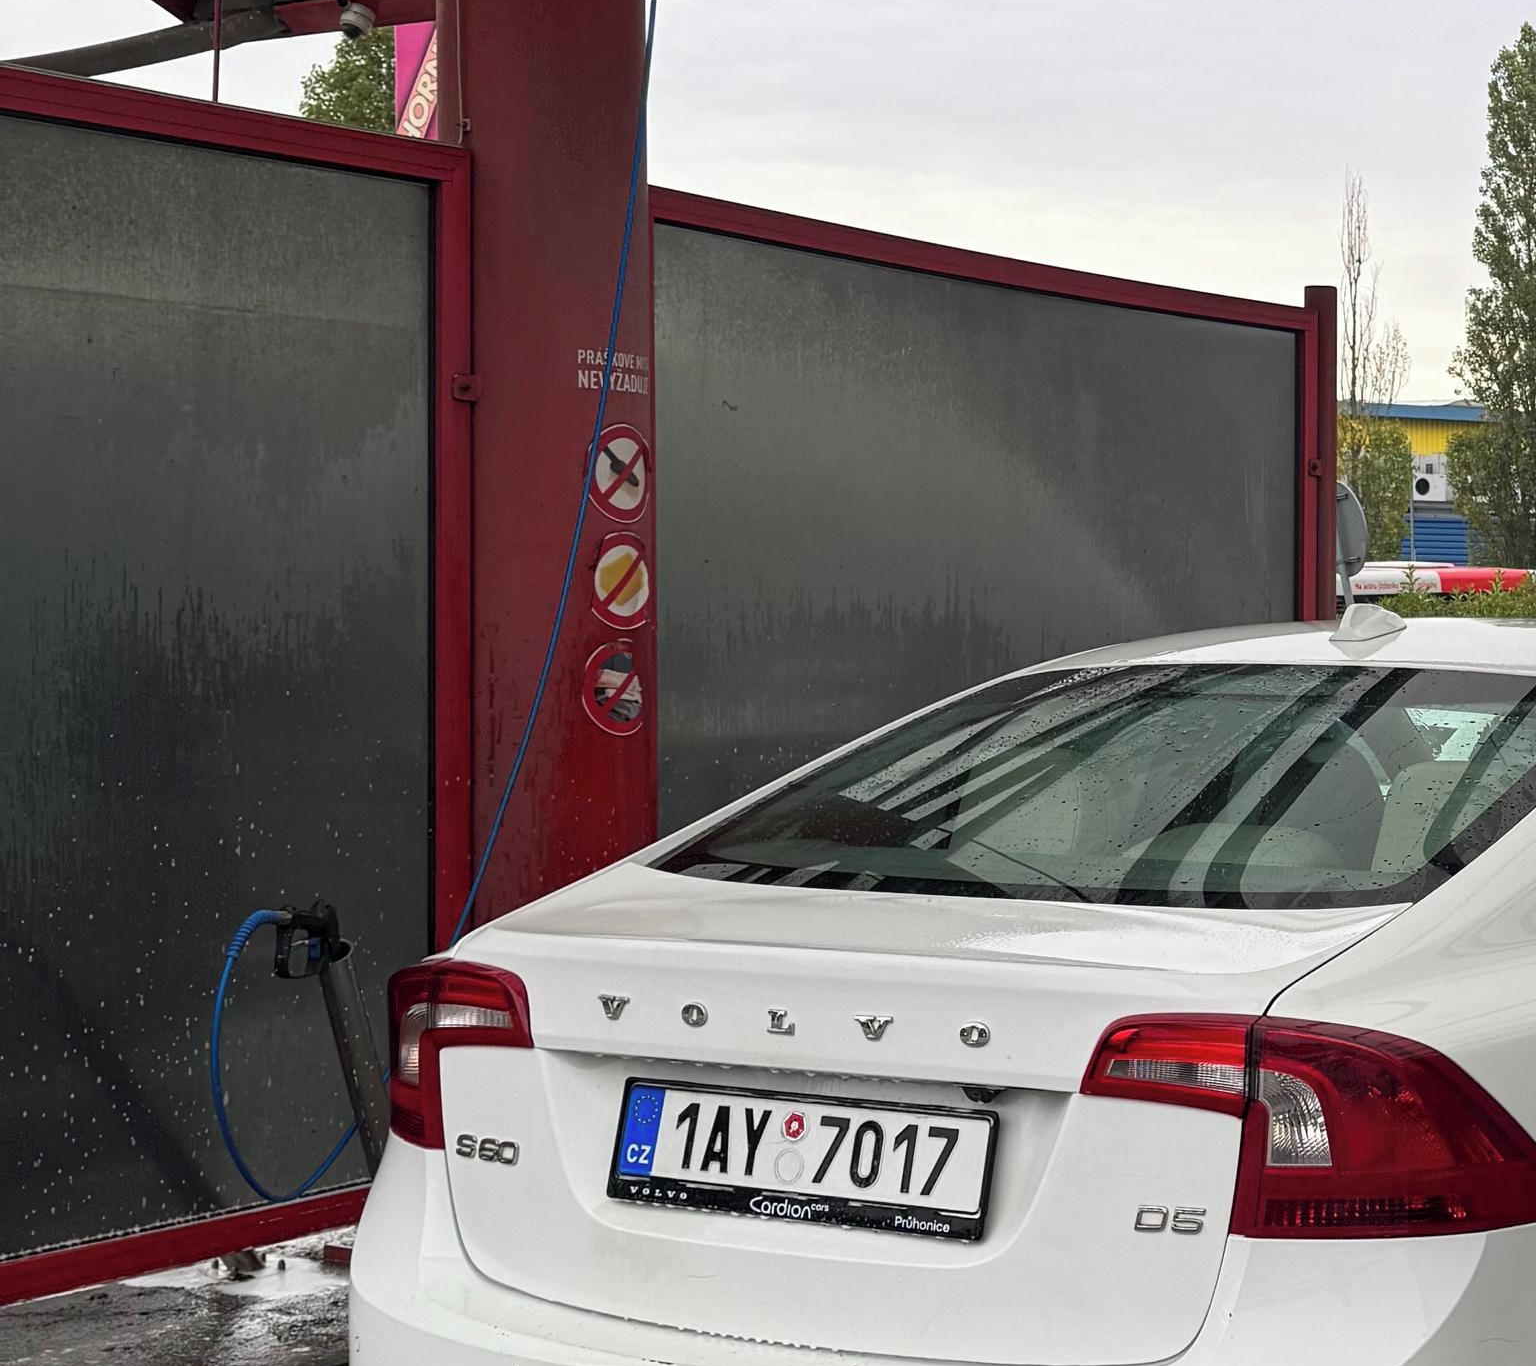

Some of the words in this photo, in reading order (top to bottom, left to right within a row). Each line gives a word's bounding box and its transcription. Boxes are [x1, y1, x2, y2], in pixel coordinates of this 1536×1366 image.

[598, 994, 991, 1048] VOLVO
[456, 1134, 519, 1166] S60
[626, 1143, 651, 1165] CZ
[675, 1102, 773, 1176] 1AY
[811, 1115, 960, 1196] 7017
[629, 1185, 688, 1200] VOLVO
[749, 1195, 811, 1219] Cardion
[810, 1201, 830, 1213] cars
[1134, 1204, 1206, 1235] D5
[894, 1215, 951, 1234] Průhonice
